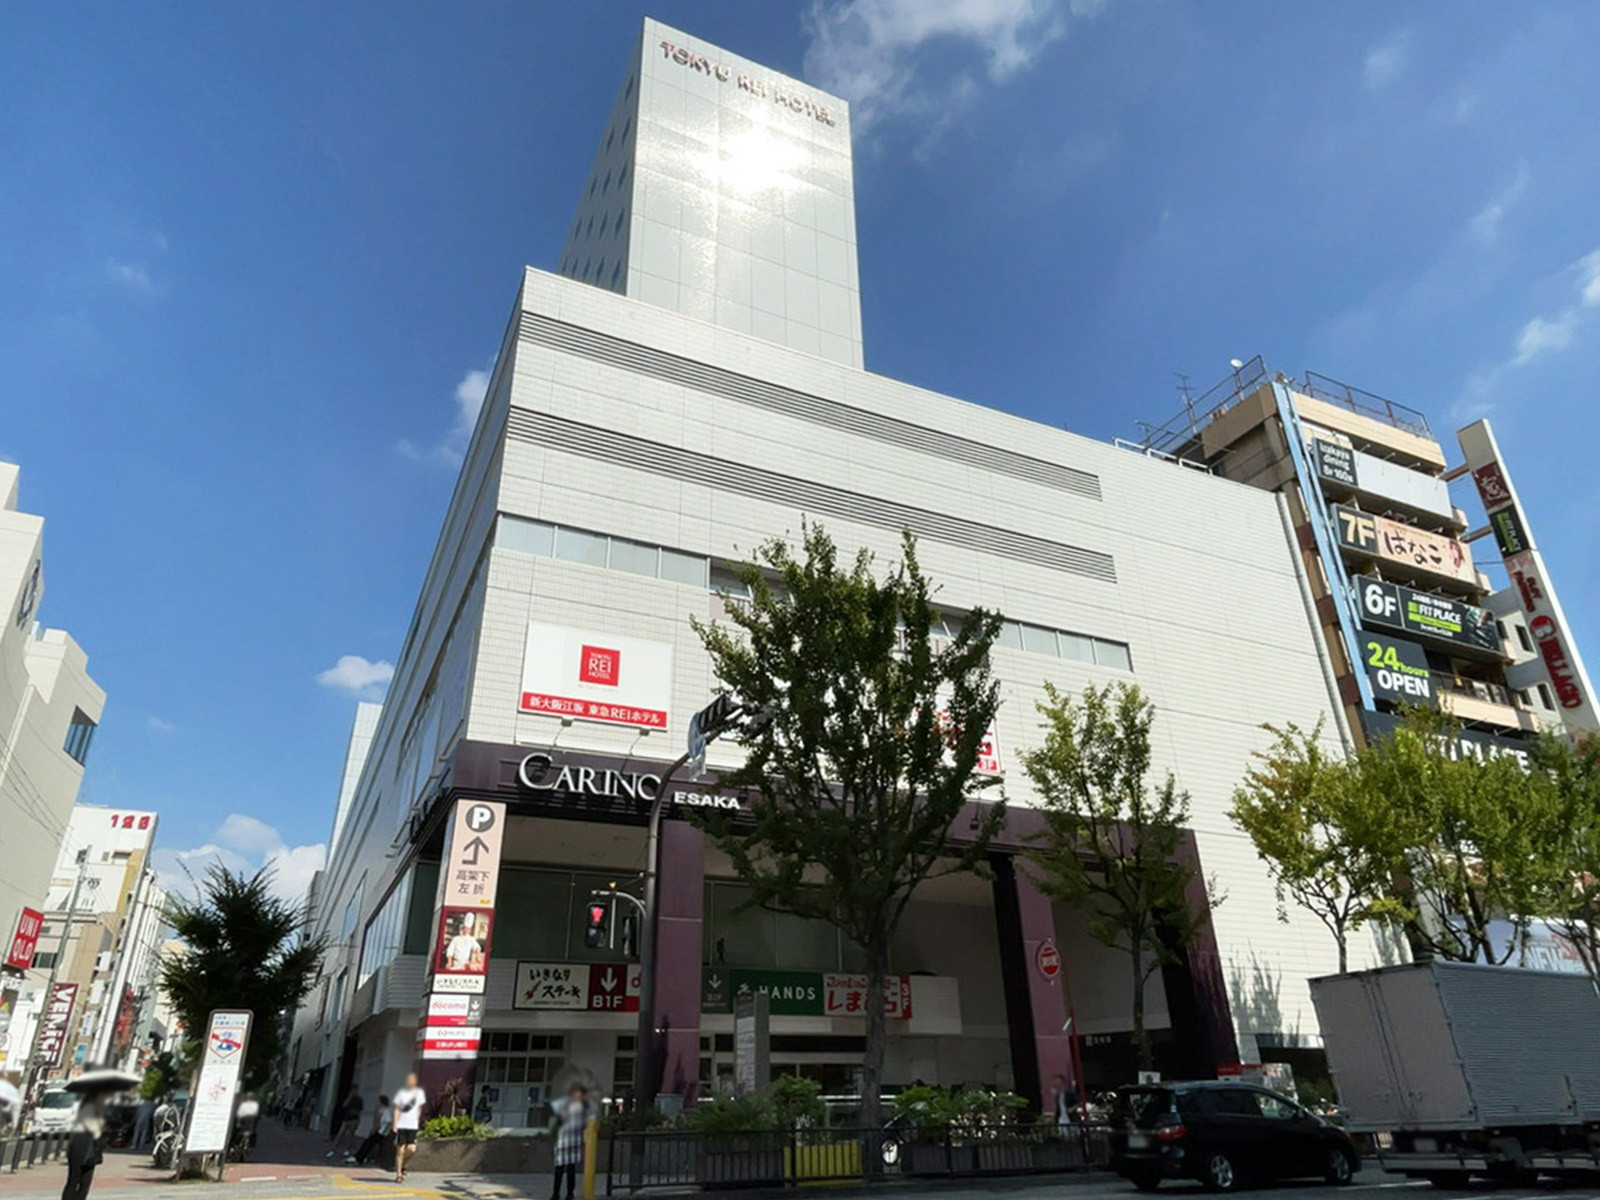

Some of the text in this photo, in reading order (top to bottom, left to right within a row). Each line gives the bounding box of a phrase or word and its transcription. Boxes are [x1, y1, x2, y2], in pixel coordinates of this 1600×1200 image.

[660, 41, 731, 83] TOKYU
[1339, 511, 1376, 547] 7F
[1384, 530, 1442, 565] はなこ
[1365, 584, 1396, 617] 6F
[1419, 604, 1433, 617] FIT
[1433, 608, 1461, 625] PLACE
[589, 658, 611, 673] REI
[1377, 669, 1430, 698] OPEN
[530, 696, 660, 723] 新大阪江坂 東急REIホテル
[674, 791, 741, 810] ESAKA
[472, 807, 491, 829] P
[456, 870, 490, 881] 高架下
[19, 915, 39, 937] UNI
[12, 938, 33, 961] QLO
[530, 968, 571, 981] いきなり
[542, 985, 581, 999] ステーキ
[593, 995, 623, 1008] B1F
[760, 985, 816, 1000] HANDS
[828, 990, 898, 1013] しまら
[432, 1001, 467, 1010] docomo
[42, 986, 75, 1063] VENICE
